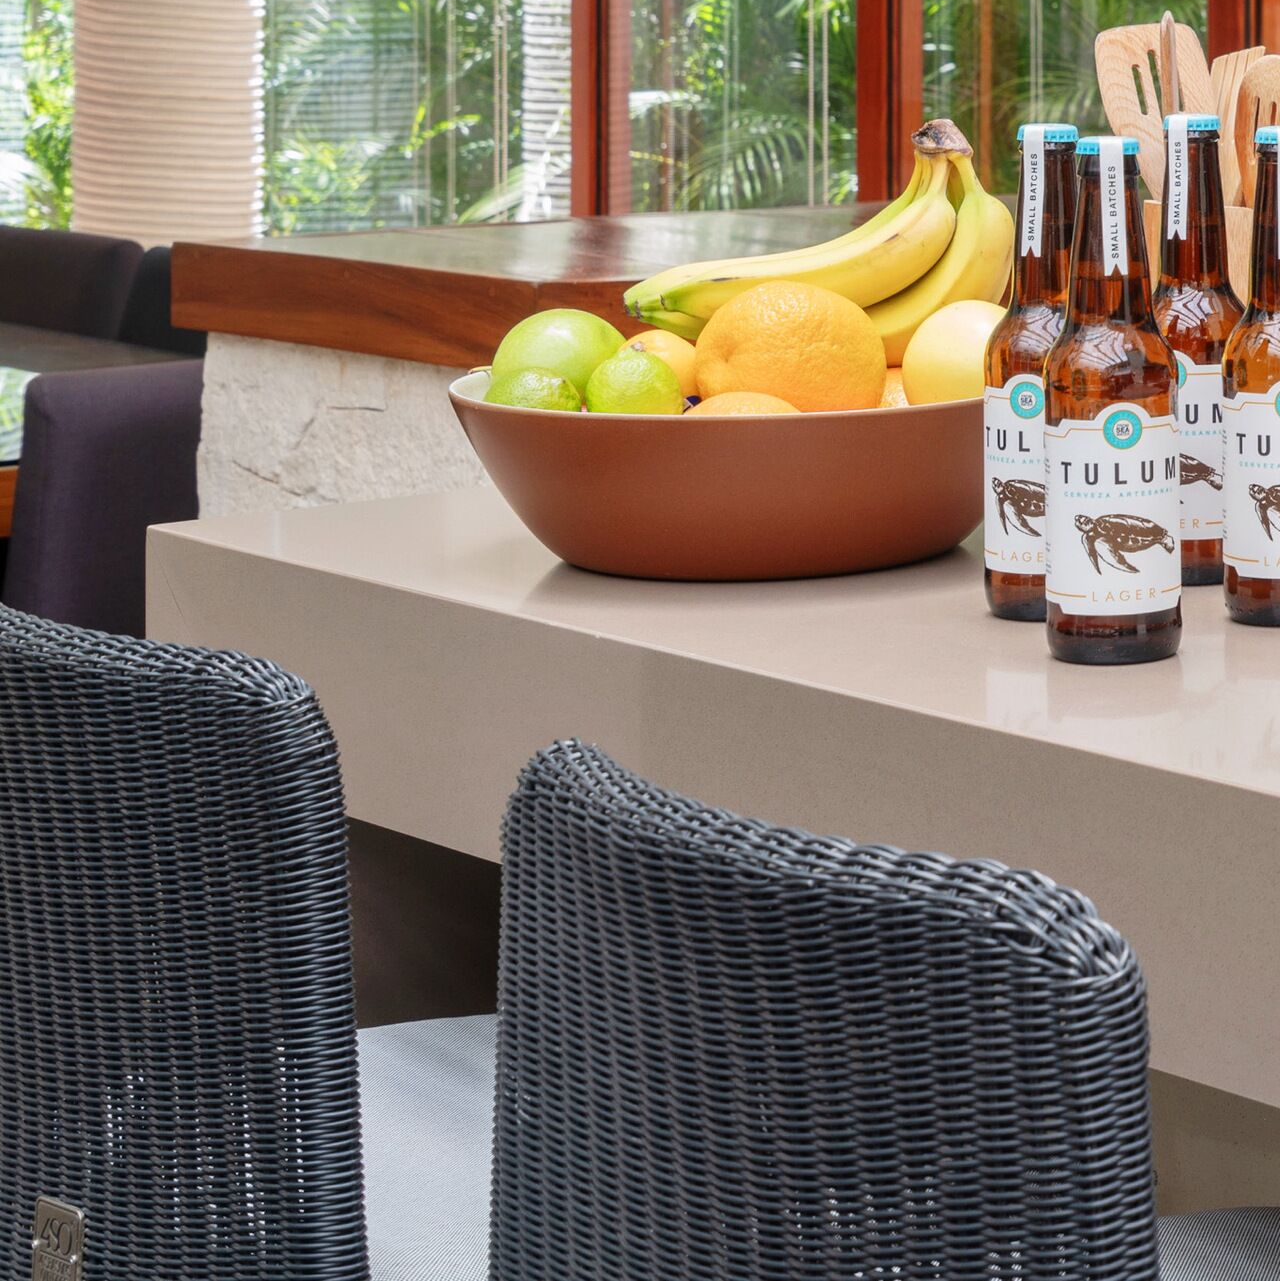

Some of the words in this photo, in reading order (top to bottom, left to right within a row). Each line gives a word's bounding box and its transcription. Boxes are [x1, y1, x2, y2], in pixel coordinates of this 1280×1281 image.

[1029, 153, 1038, 201] BATCHES
[1174, 141, 1182, 187] BATCHES
[1107, 165, 1118, 217] BATCHES
[1027, 206, 1036, 241] SMALL
[1173, 192, 1182, 225] SMALL
[1110, 221, 1120, 259] SMALL
[985, 425, 1031, 453] TUL
[1061, 456, 1176, 485] TULUM
[1063, 491, 1111, 499] CERVEZA
[1119, 487, 1173, 498] ARTESANAL
[1001, 551, 1044, 564] LAGE
[1092, 587, 1157, 603] LAGER
